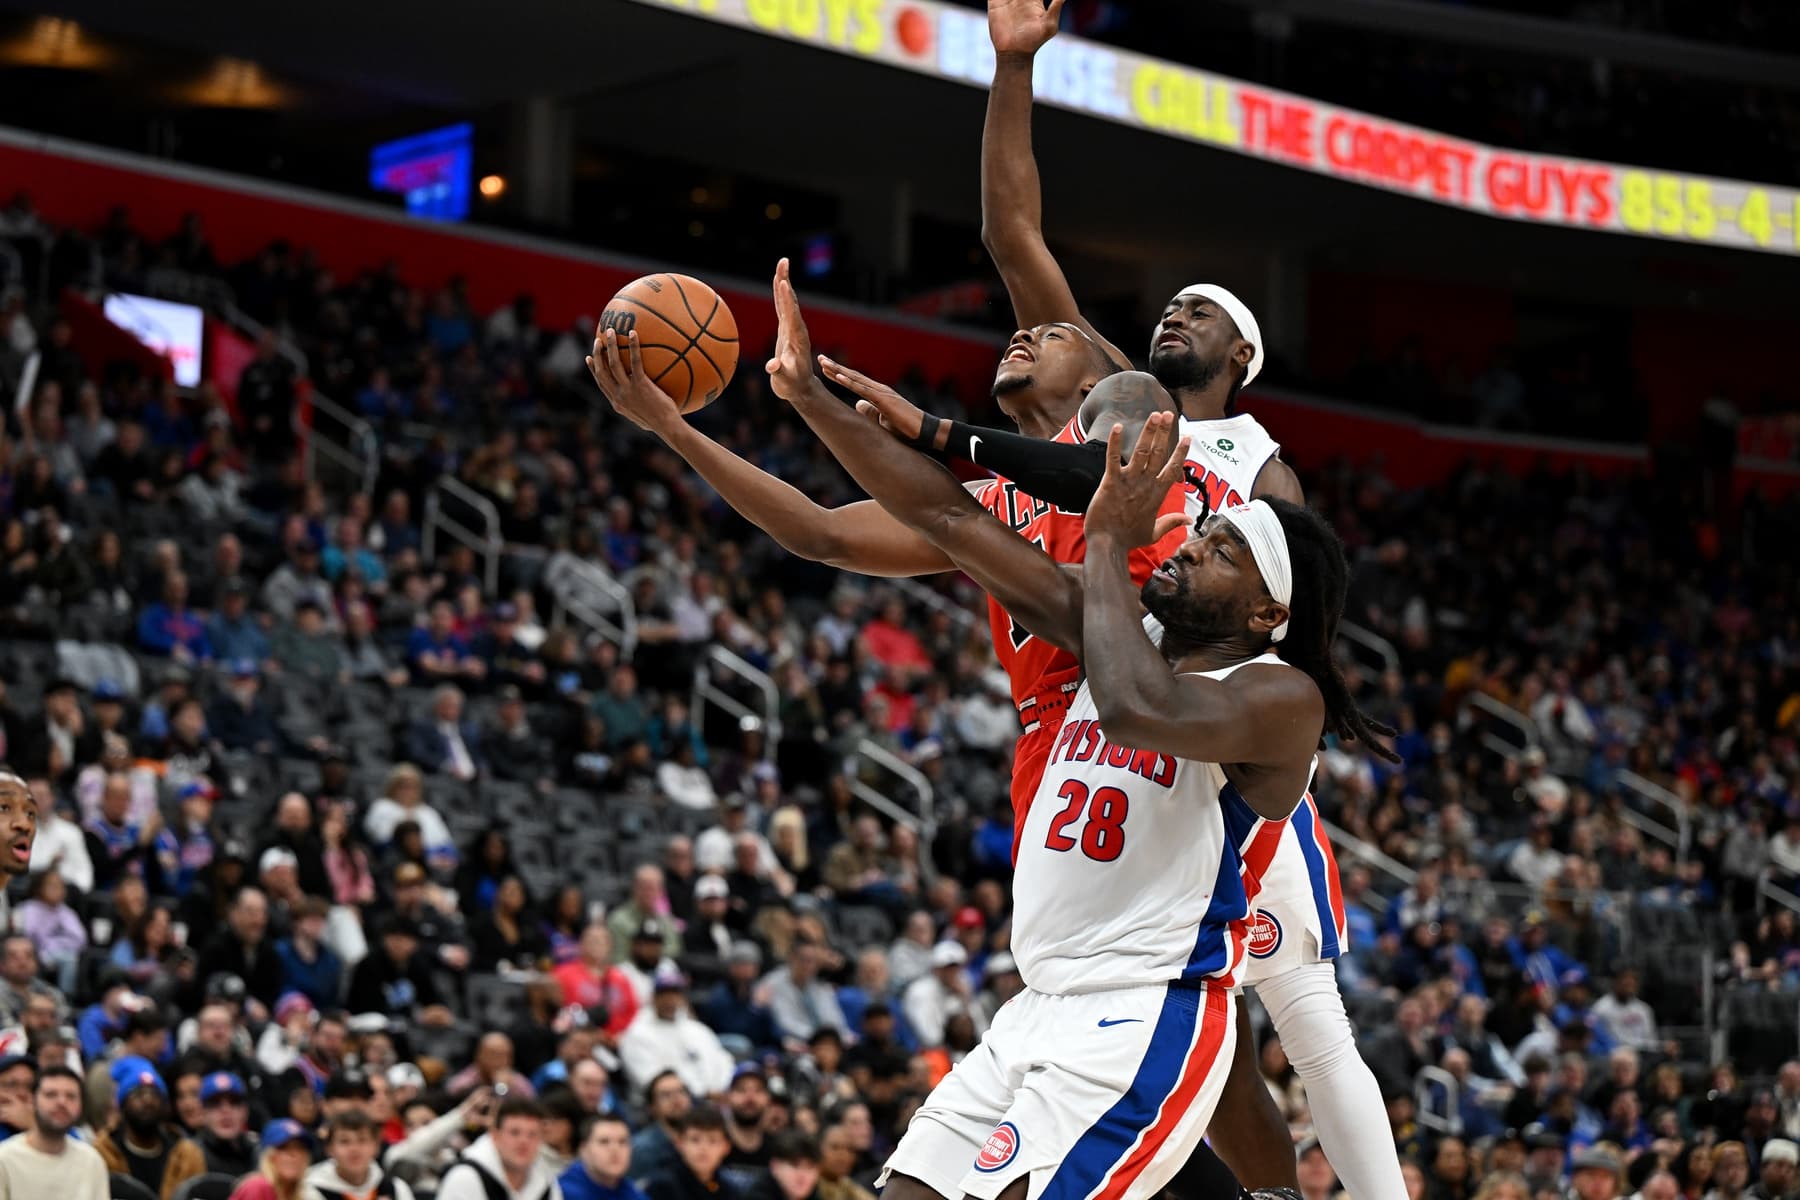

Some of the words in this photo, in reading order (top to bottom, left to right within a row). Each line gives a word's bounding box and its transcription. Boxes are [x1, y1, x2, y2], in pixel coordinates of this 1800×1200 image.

[1132, 62, 1238, 145] CALL
[1238, 89, 1314, 167] THE
[1324, 114, 1477, 208] CARPET
[1486, 156, 1613, 230] GUYS
[1620, 170, 1800, 248] 855-4-
[1044, 778, 1129, 862] 28
